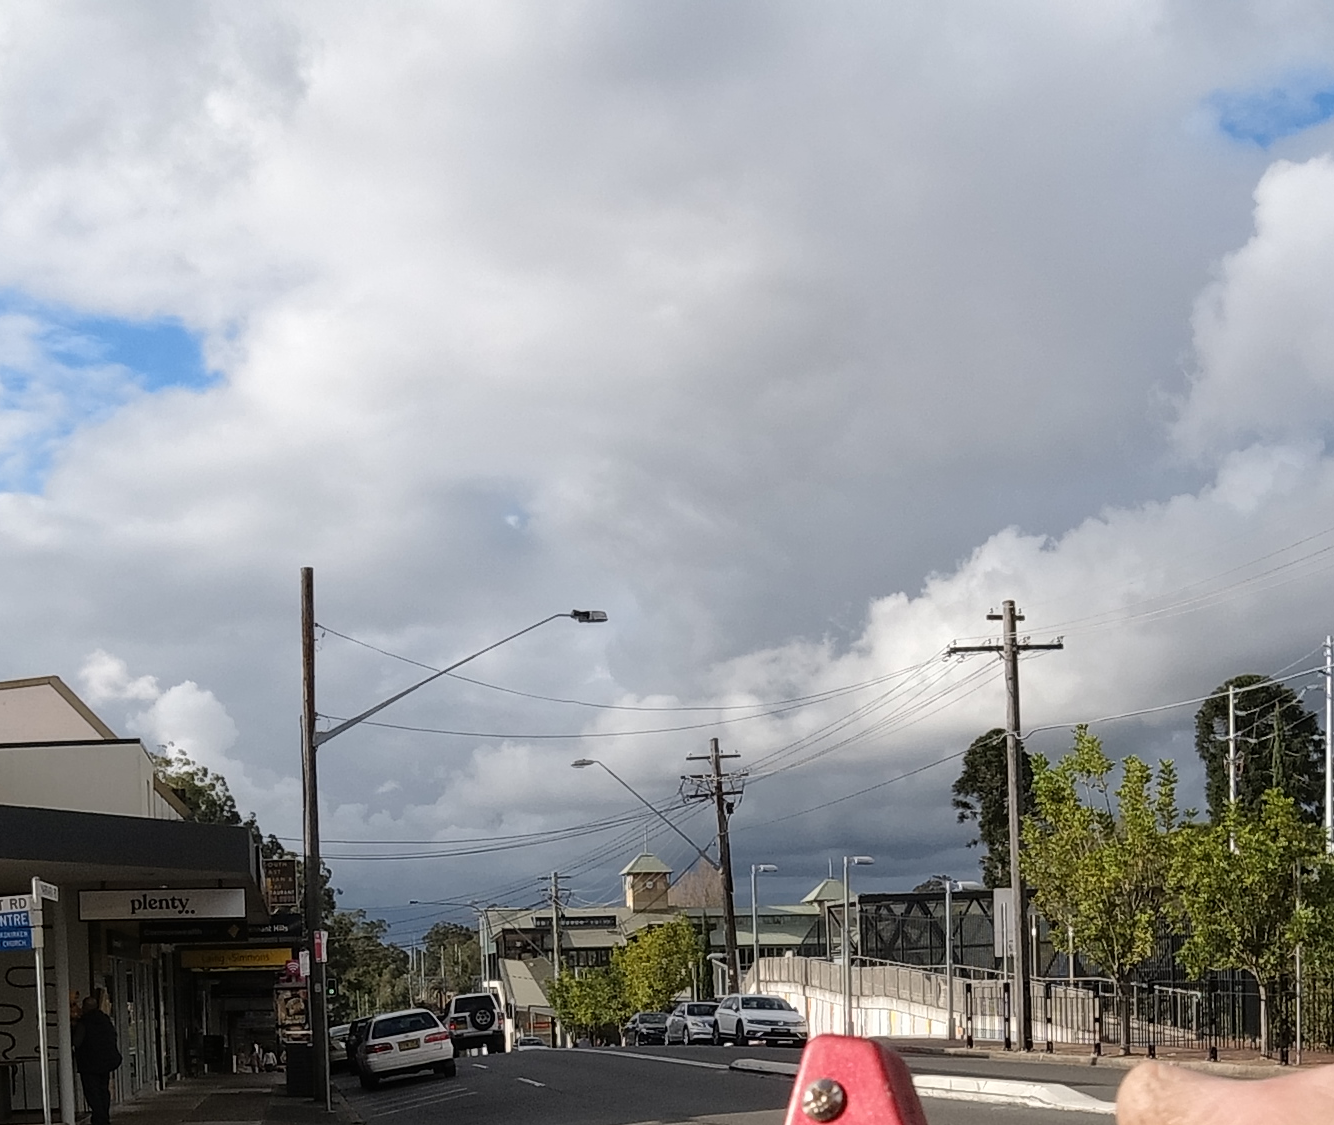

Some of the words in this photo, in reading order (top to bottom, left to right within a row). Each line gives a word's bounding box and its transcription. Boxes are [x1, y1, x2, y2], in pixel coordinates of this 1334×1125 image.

[10, 897, 27, 910] RD
[273, 924, 289, 933] Hills
[2, 940, 27, 948] CHURCH
